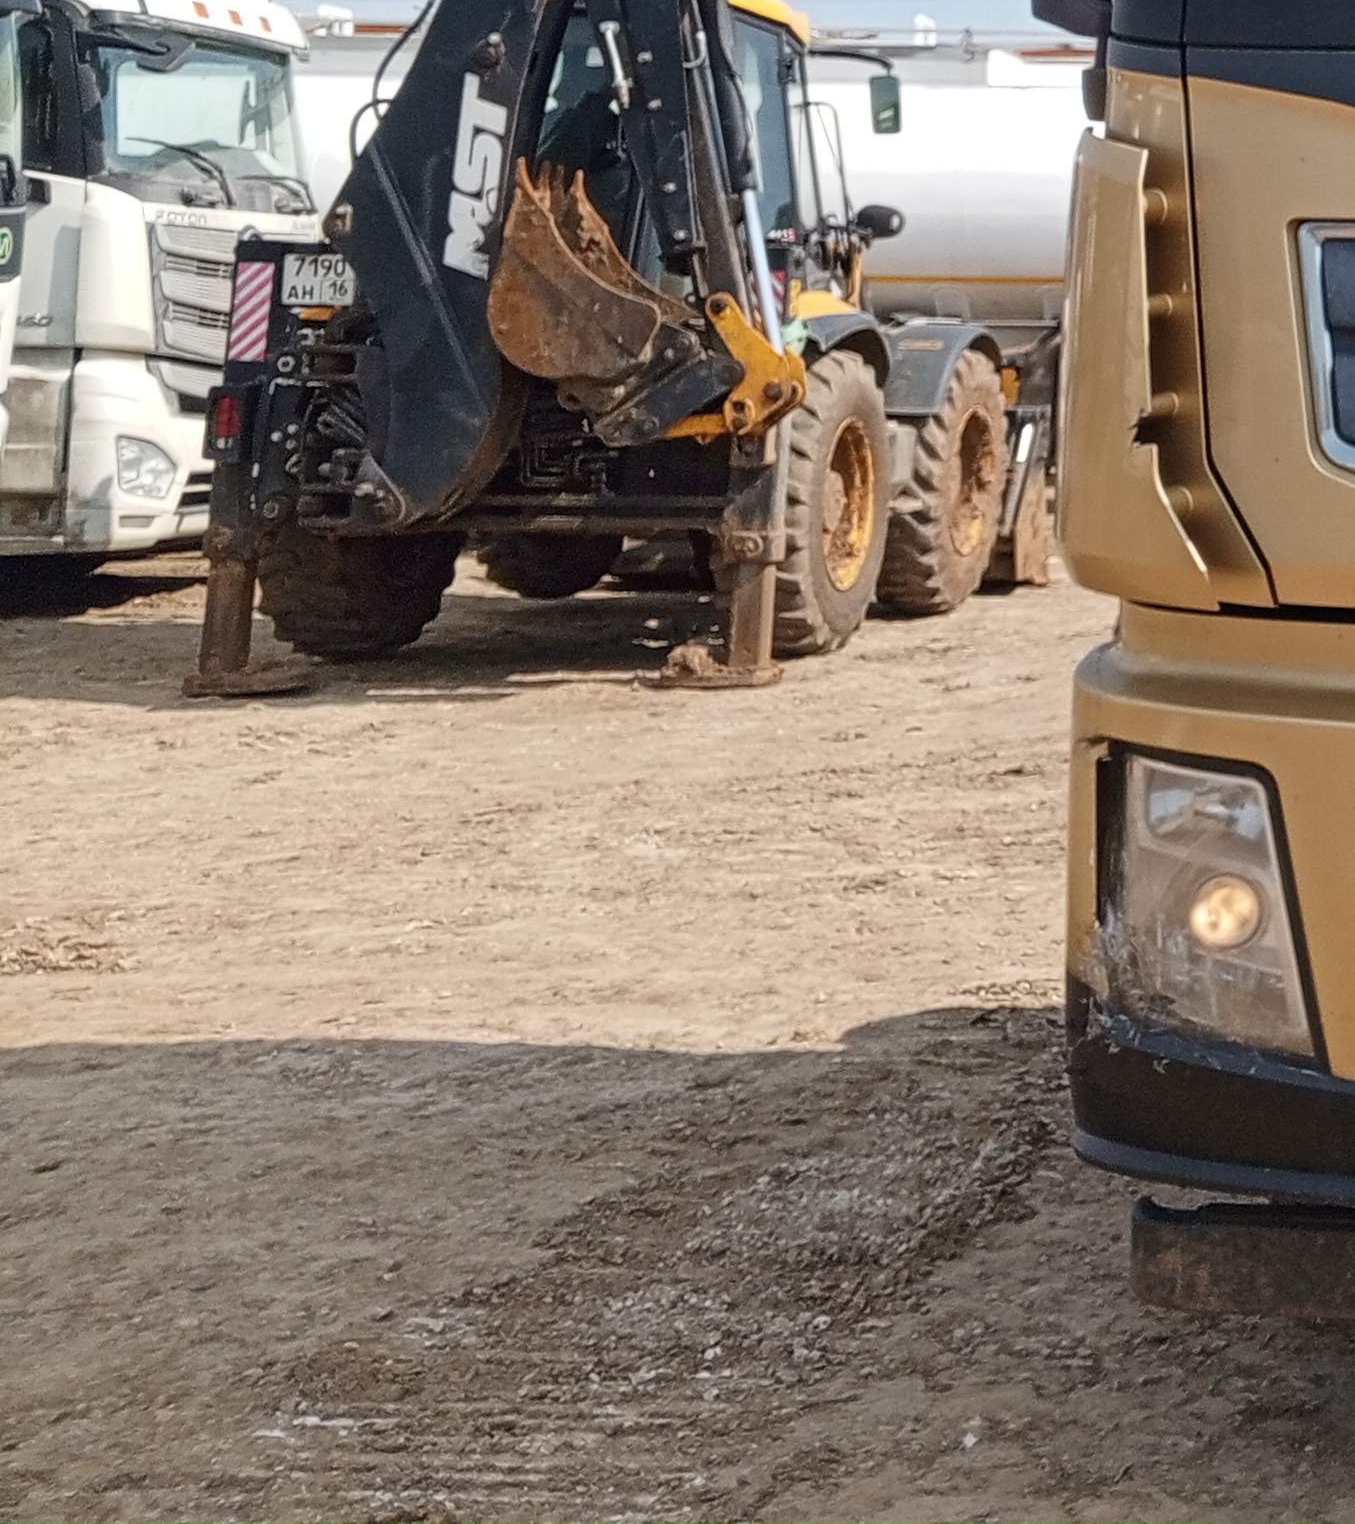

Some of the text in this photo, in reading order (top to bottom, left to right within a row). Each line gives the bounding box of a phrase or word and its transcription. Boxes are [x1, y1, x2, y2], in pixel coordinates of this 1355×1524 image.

[442, 71, 508, 280] MST
[293, 256, 346, 278] 7190
[328, 279, 348, 297] 16
